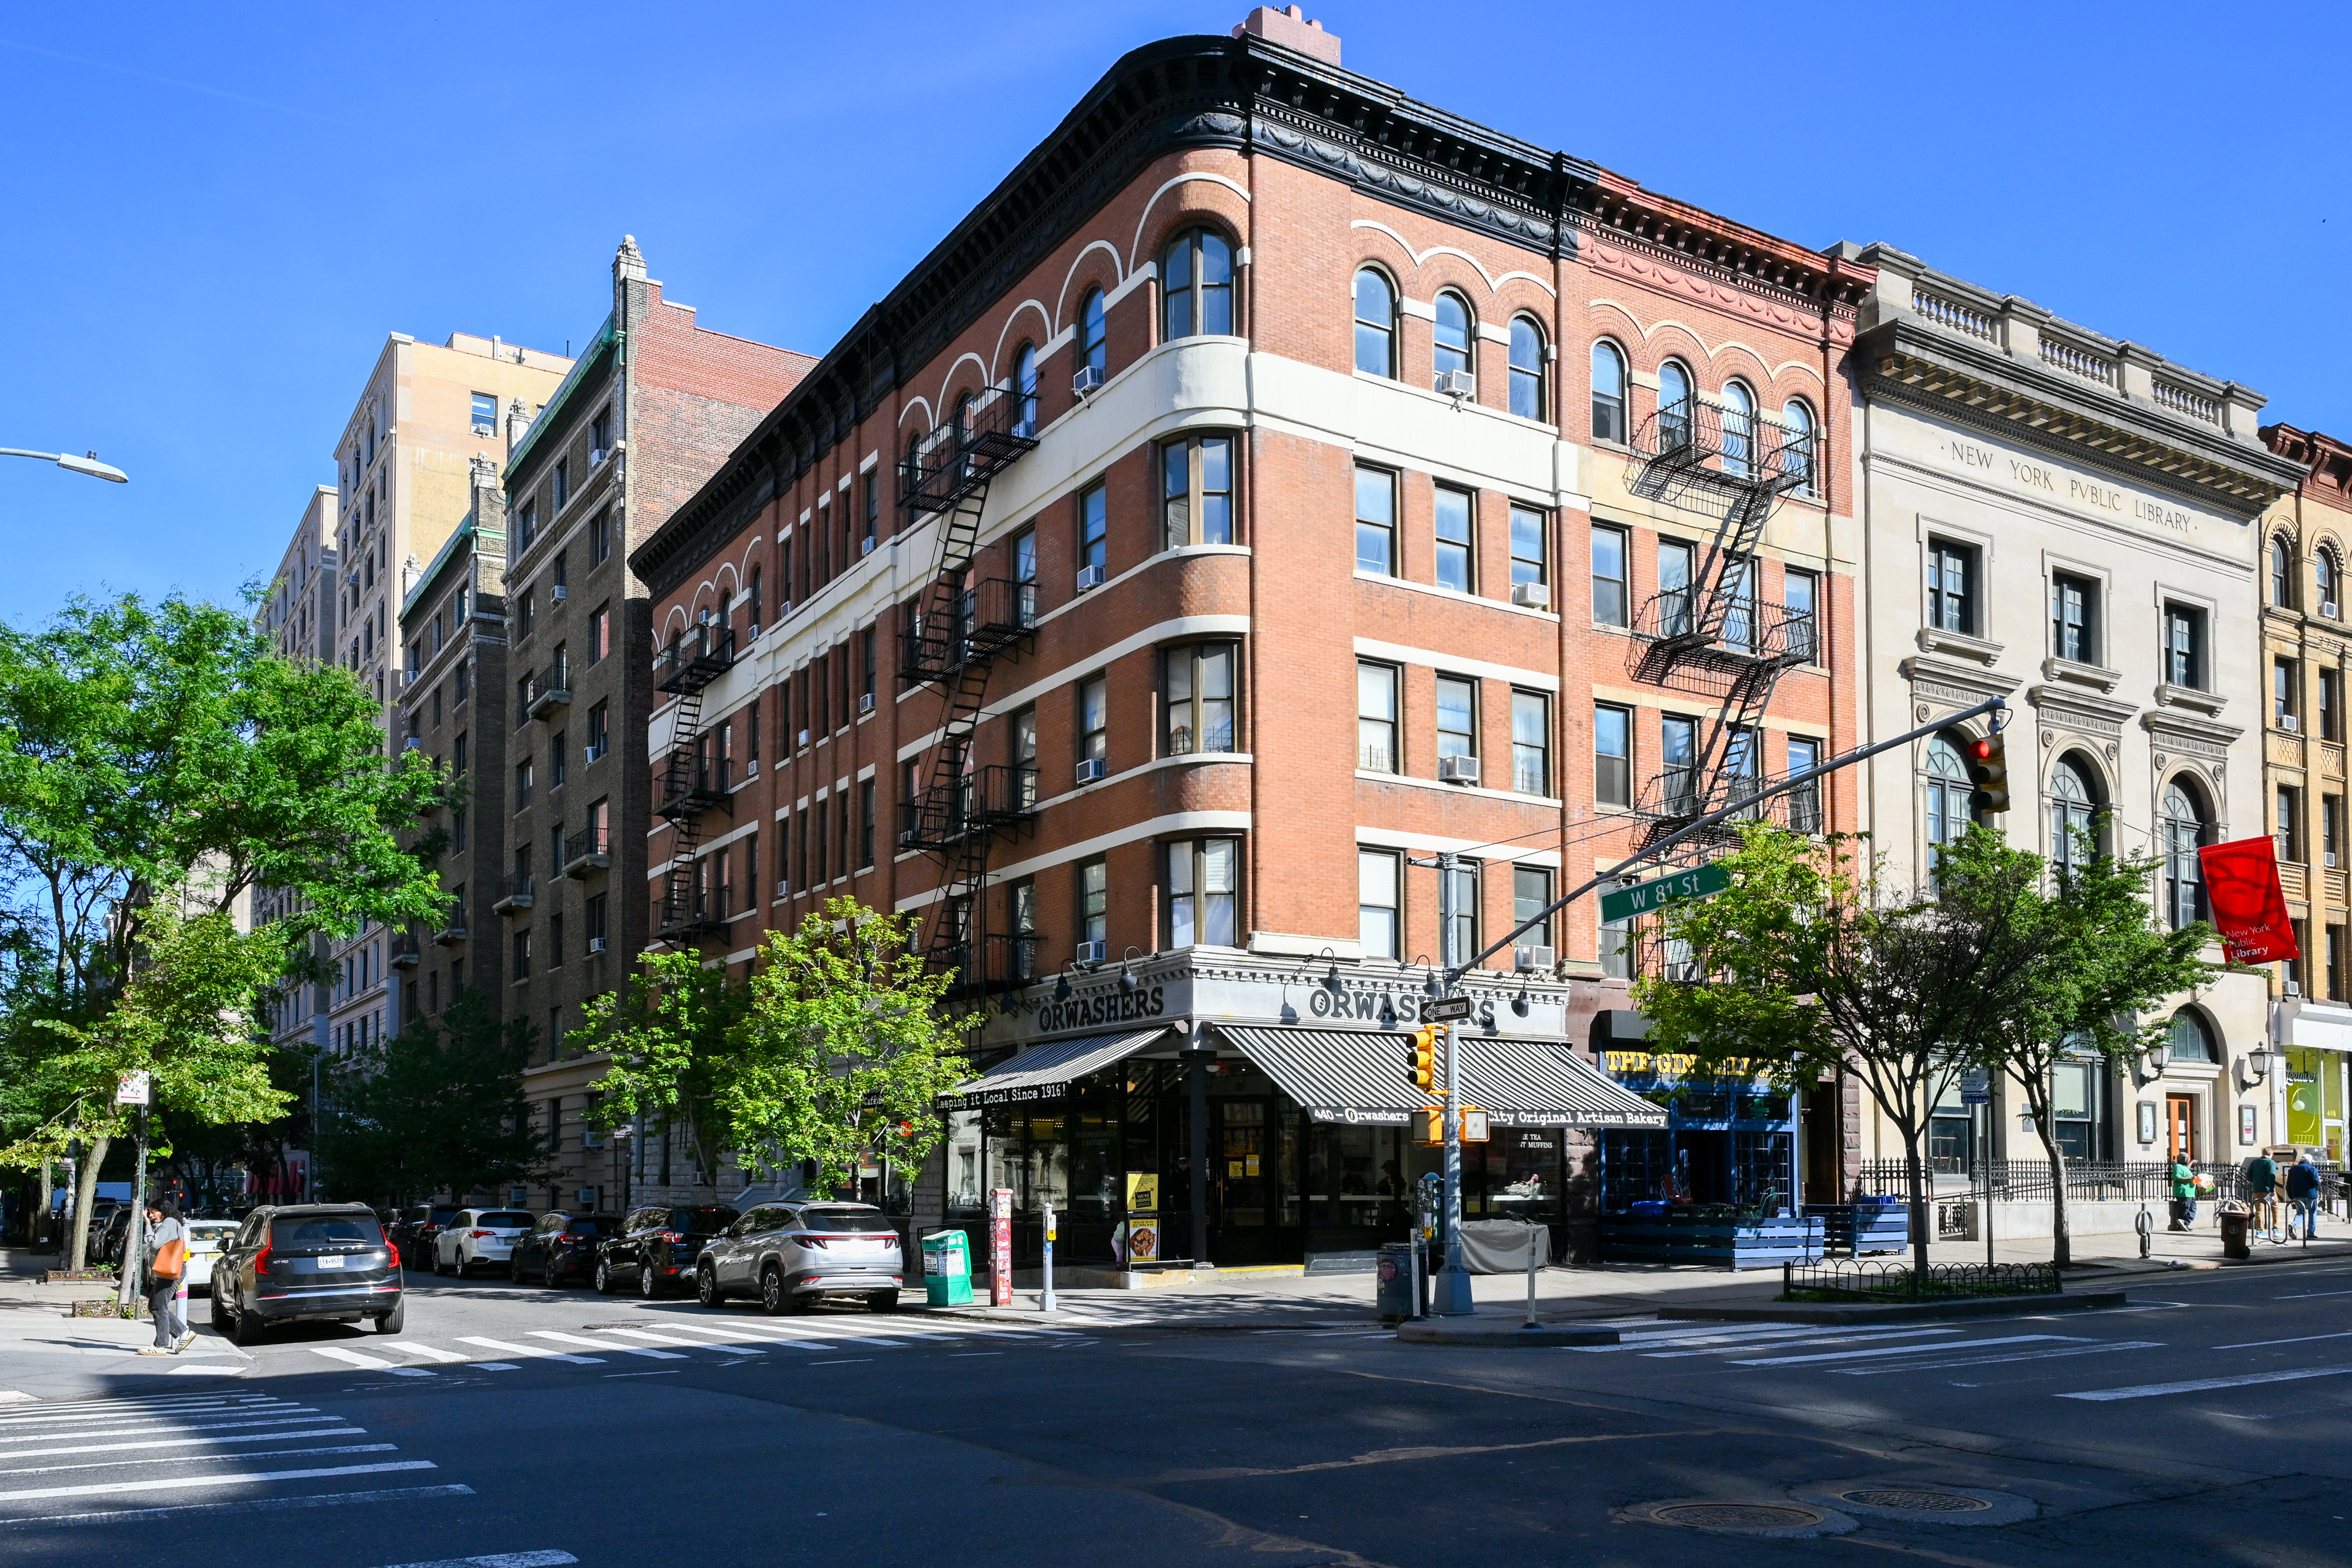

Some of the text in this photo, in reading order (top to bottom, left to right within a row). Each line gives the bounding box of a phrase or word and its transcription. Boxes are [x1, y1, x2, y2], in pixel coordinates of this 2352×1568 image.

[1952, 441, 2190, 532] NEW YORK PVBLIC LIBRARY
[1631, 874, 1699, 910] W 81 St
[2226, 924, 2271, 939] New York
[2229, 938, 2256, 948] Public
[2231, 947, 2269, 959] Library
[1039, 987, 1164, 1032] ORWASHERS
[1310, 989, 1495, 1026] ORWASRS
[1428, 1004, 1465, 1017] ONE WAY
[1605, 1051, 1651, 1072] THE
[1656, 1054, 1697, 1074] GIN
[2286, 1062, 2318, 1086] Leeuwen
[936, 1085, 1066, 1111] Keeping it Local Since 1916!
[1314, 1109, 1334, 1120] 440
[1345, 1108, 1409, 1123] Orwashers
[1488, 1111, 1666, 1126] City Original Artisan Bakery
